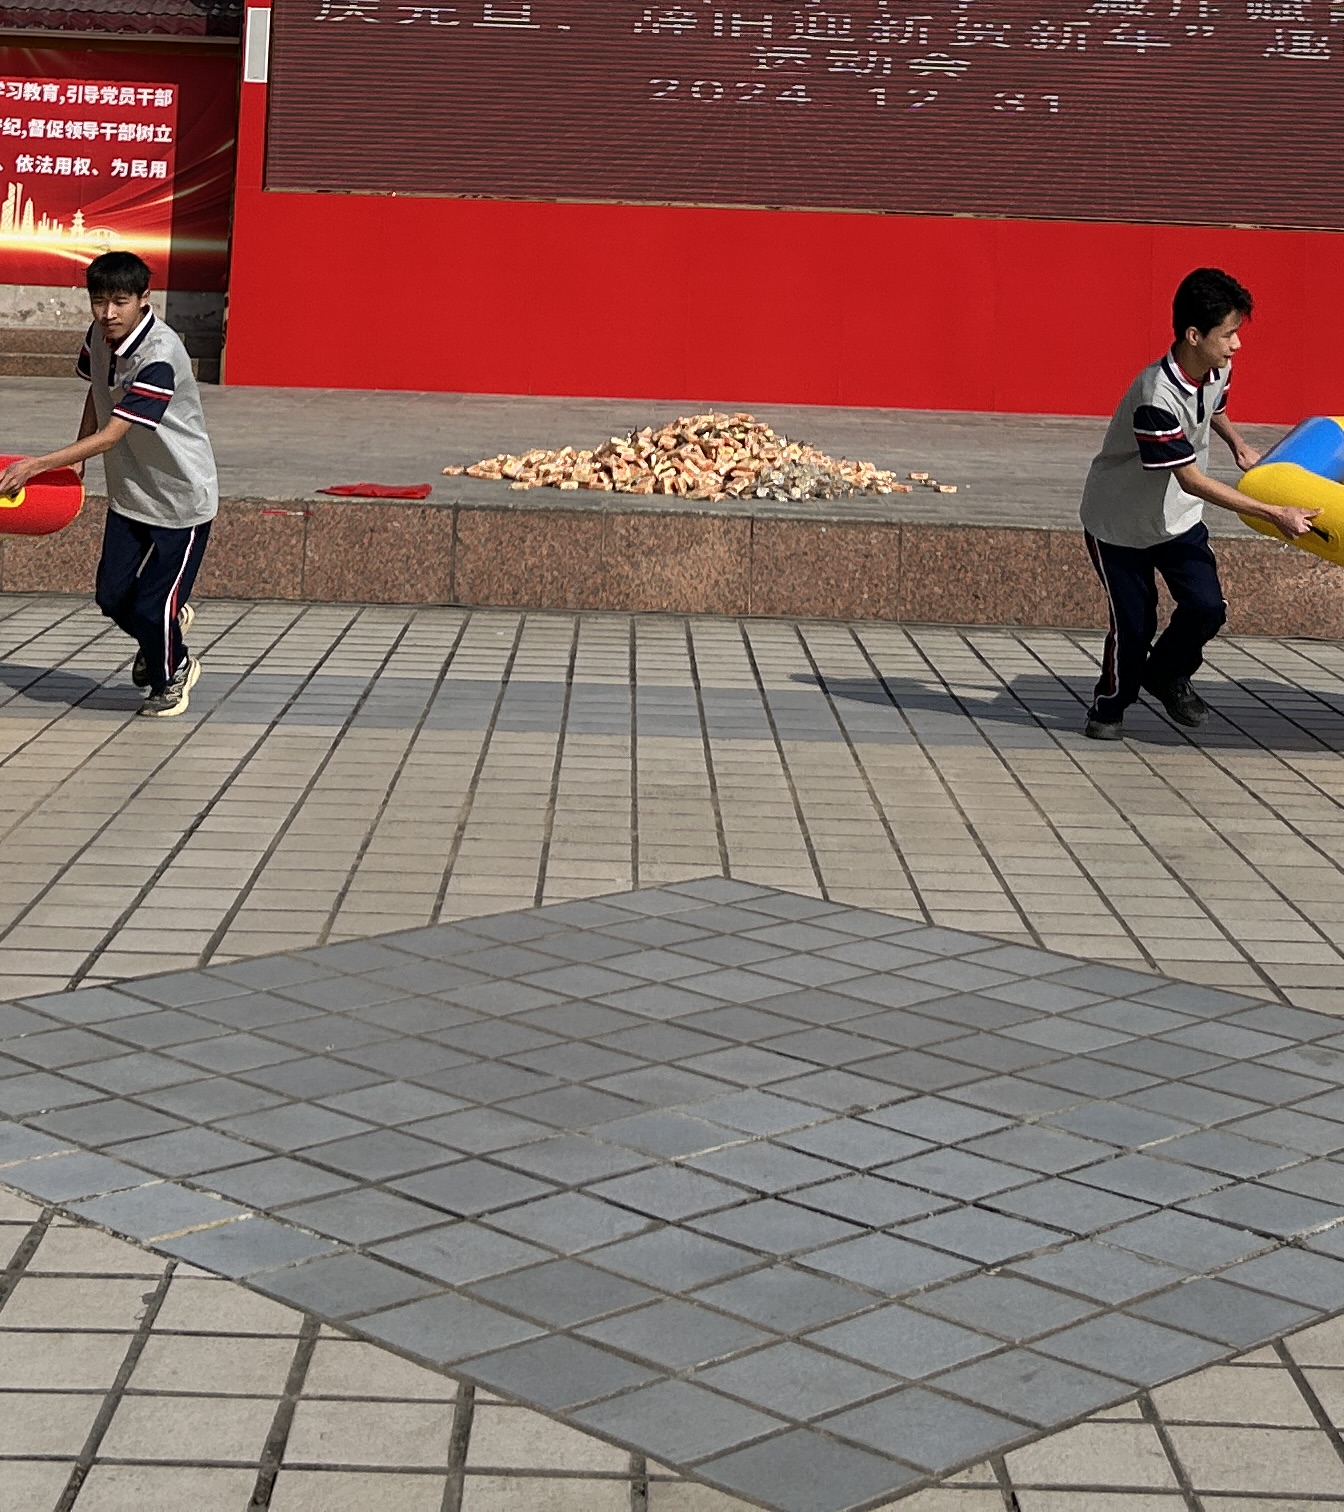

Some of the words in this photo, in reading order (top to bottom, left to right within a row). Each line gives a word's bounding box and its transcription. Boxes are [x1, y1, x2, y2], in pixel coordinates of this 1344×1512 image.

[748, 45, 972, 81] 运动会
[648, 78, 1060, 115] 2024.1231
